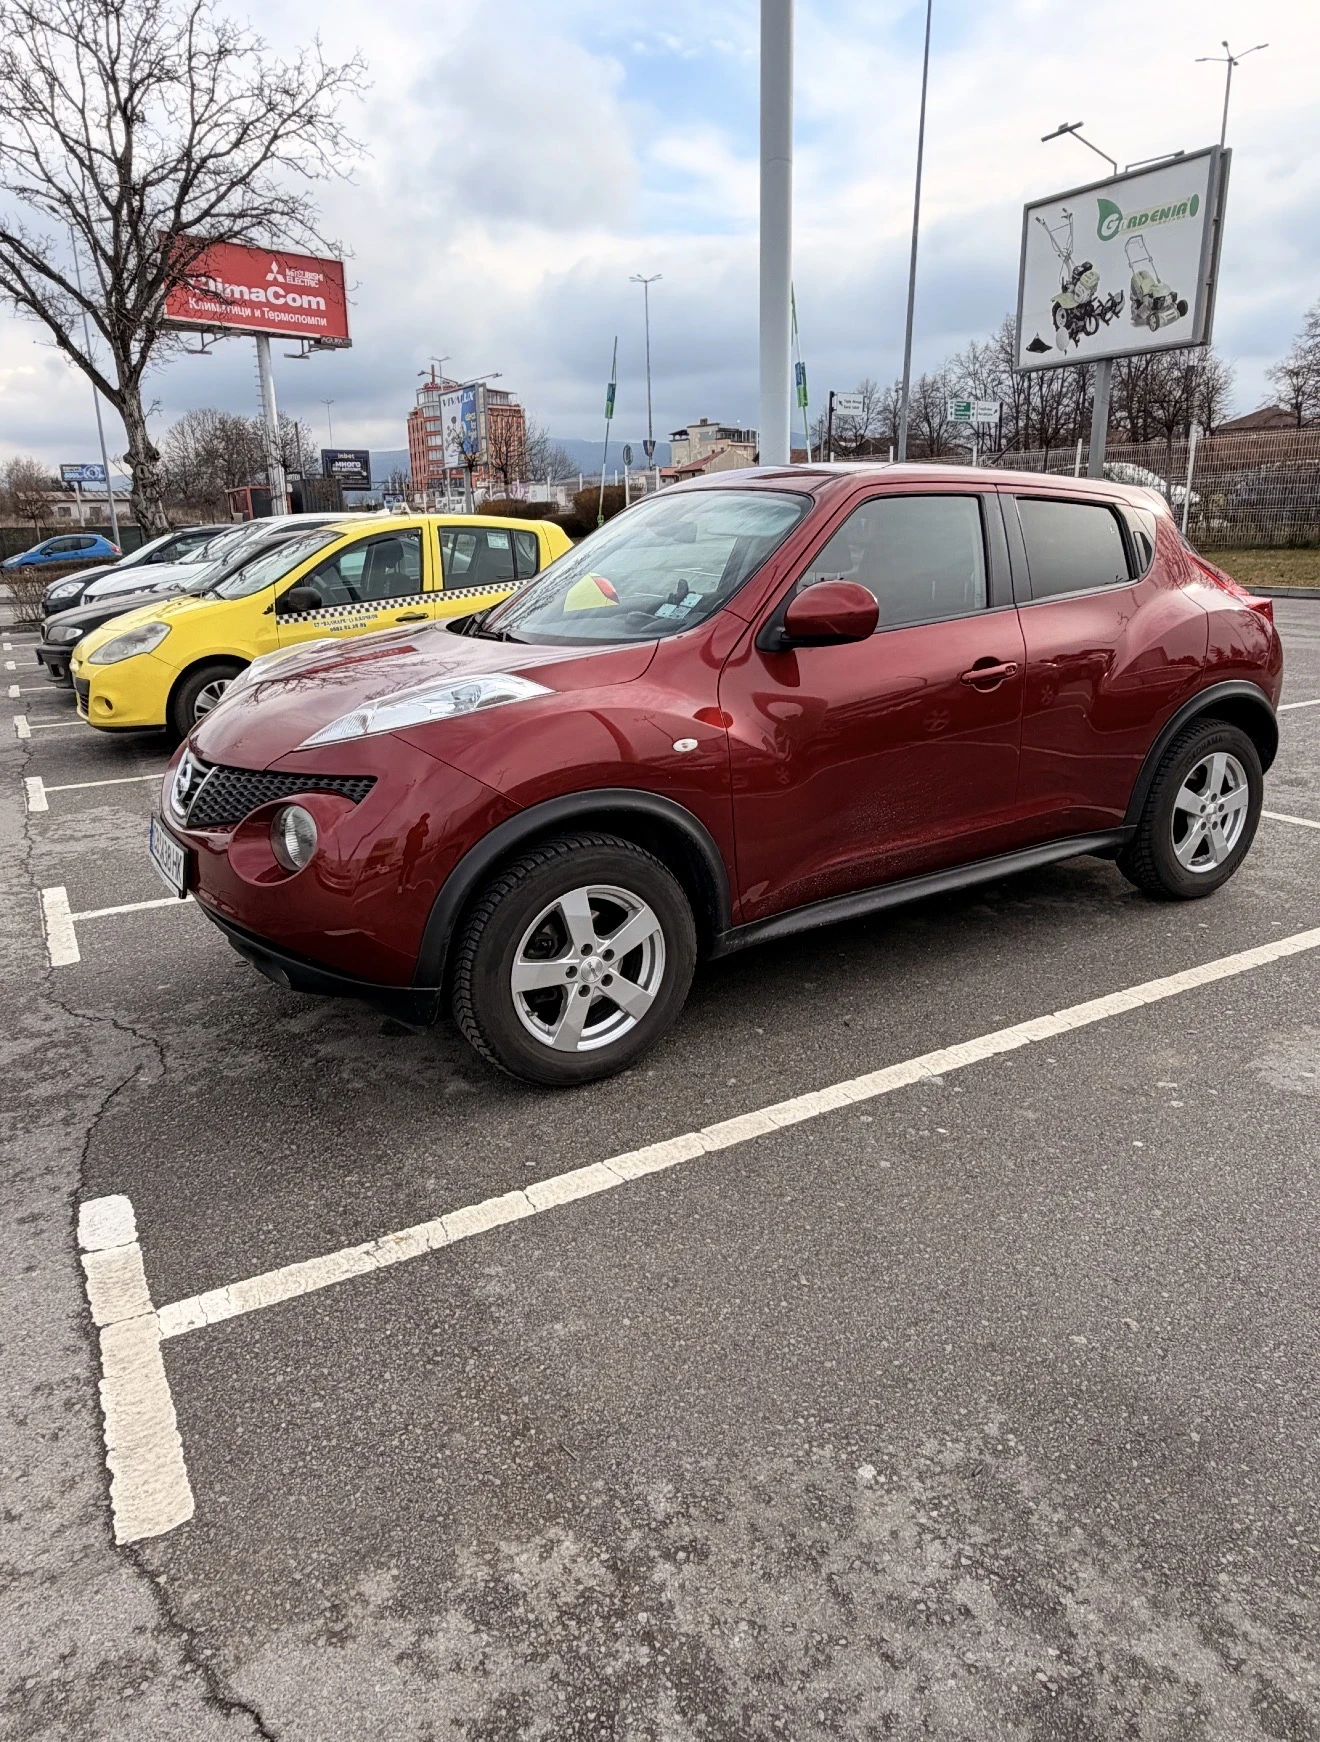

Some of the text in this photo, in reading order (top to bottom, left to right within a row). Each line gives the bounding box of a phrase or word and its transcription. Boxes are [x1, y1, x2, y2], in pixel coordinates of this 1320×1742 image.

[286, 276, 320, 288] ELECTRIC
[254, 308, 261, 318] и
[262, 307, 327, 326] Термопомпи
[442, 391, 475, 408] VIVALUX
